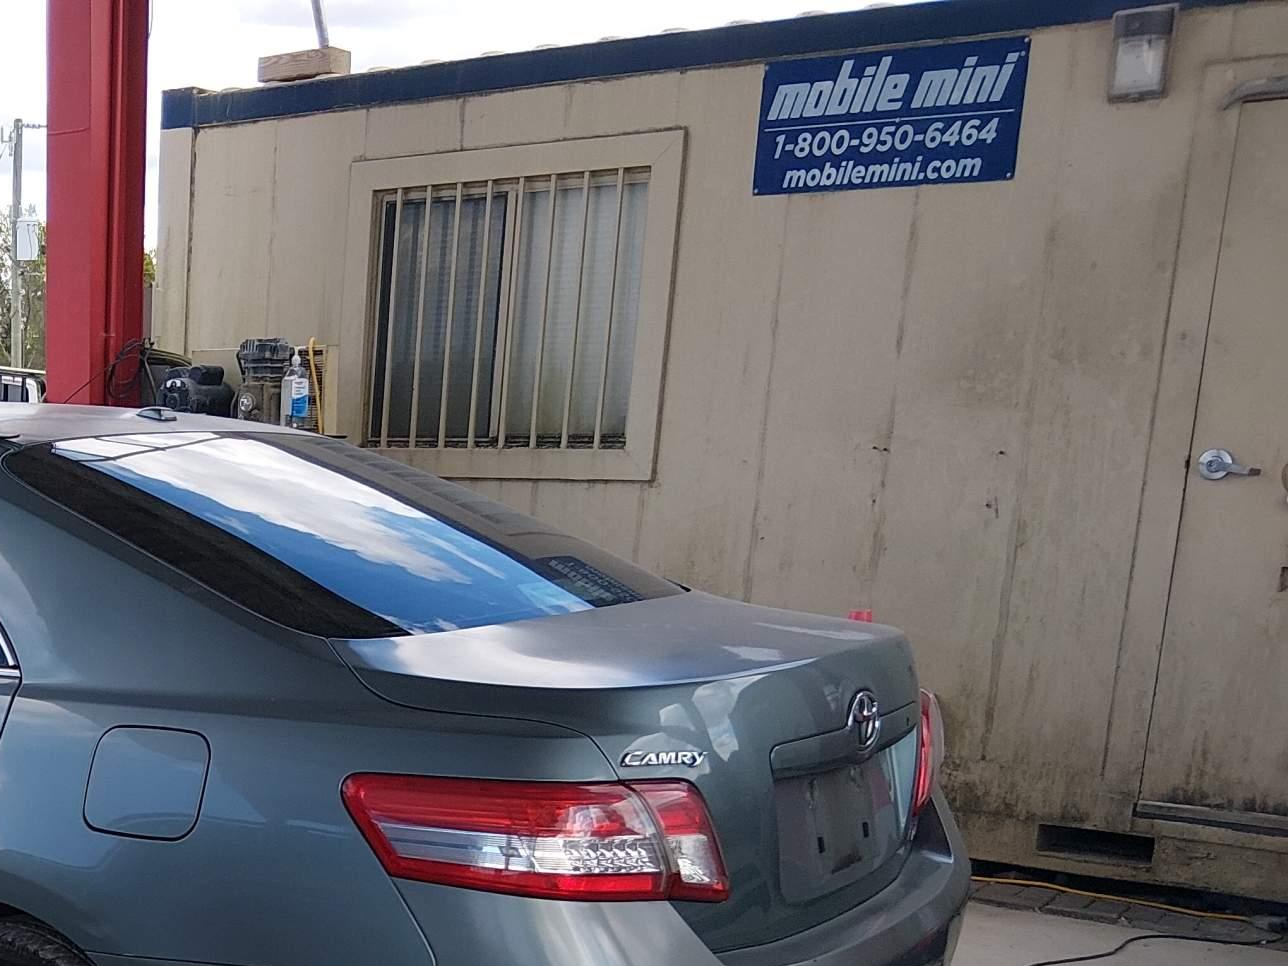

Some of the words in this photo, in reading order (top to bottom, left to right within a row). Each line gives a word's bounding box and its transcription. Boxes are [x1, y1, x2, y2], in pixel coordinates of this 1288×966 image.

[767, 55, 910, 120] mobile
[910, 52, 1020, 109] mini
[773, 117, 1000, 159] 1-800-950-6464
[782, 156, 982, 188] mobilemini.com
[621, 751, 709, 767] CAMRY
